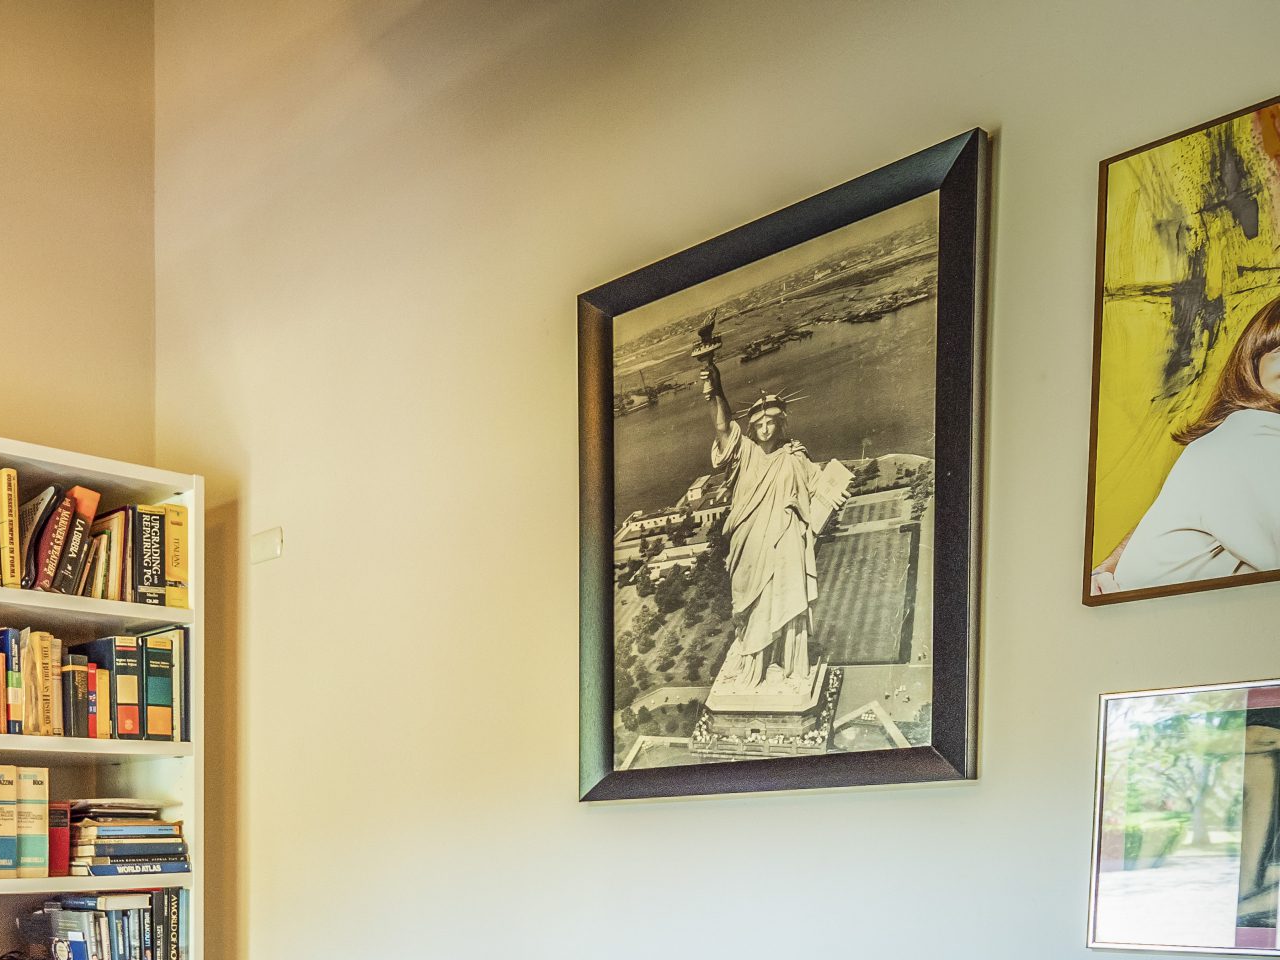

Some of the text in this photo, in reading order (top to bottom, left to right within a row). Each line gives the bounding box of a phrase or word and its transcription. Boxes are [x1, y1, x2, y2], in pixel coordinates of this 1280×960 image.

[74, 518, 86, 530] LA
[142, 515, 153, 586] REPAIRING PCs
[150, 516, 161, 574] UPGRADING
[172, 538, 181, 568] ITALIAN
[116, 864, 161, 873] WORLD ATLAS
[170, 901, 178, 943] WORLD OF
